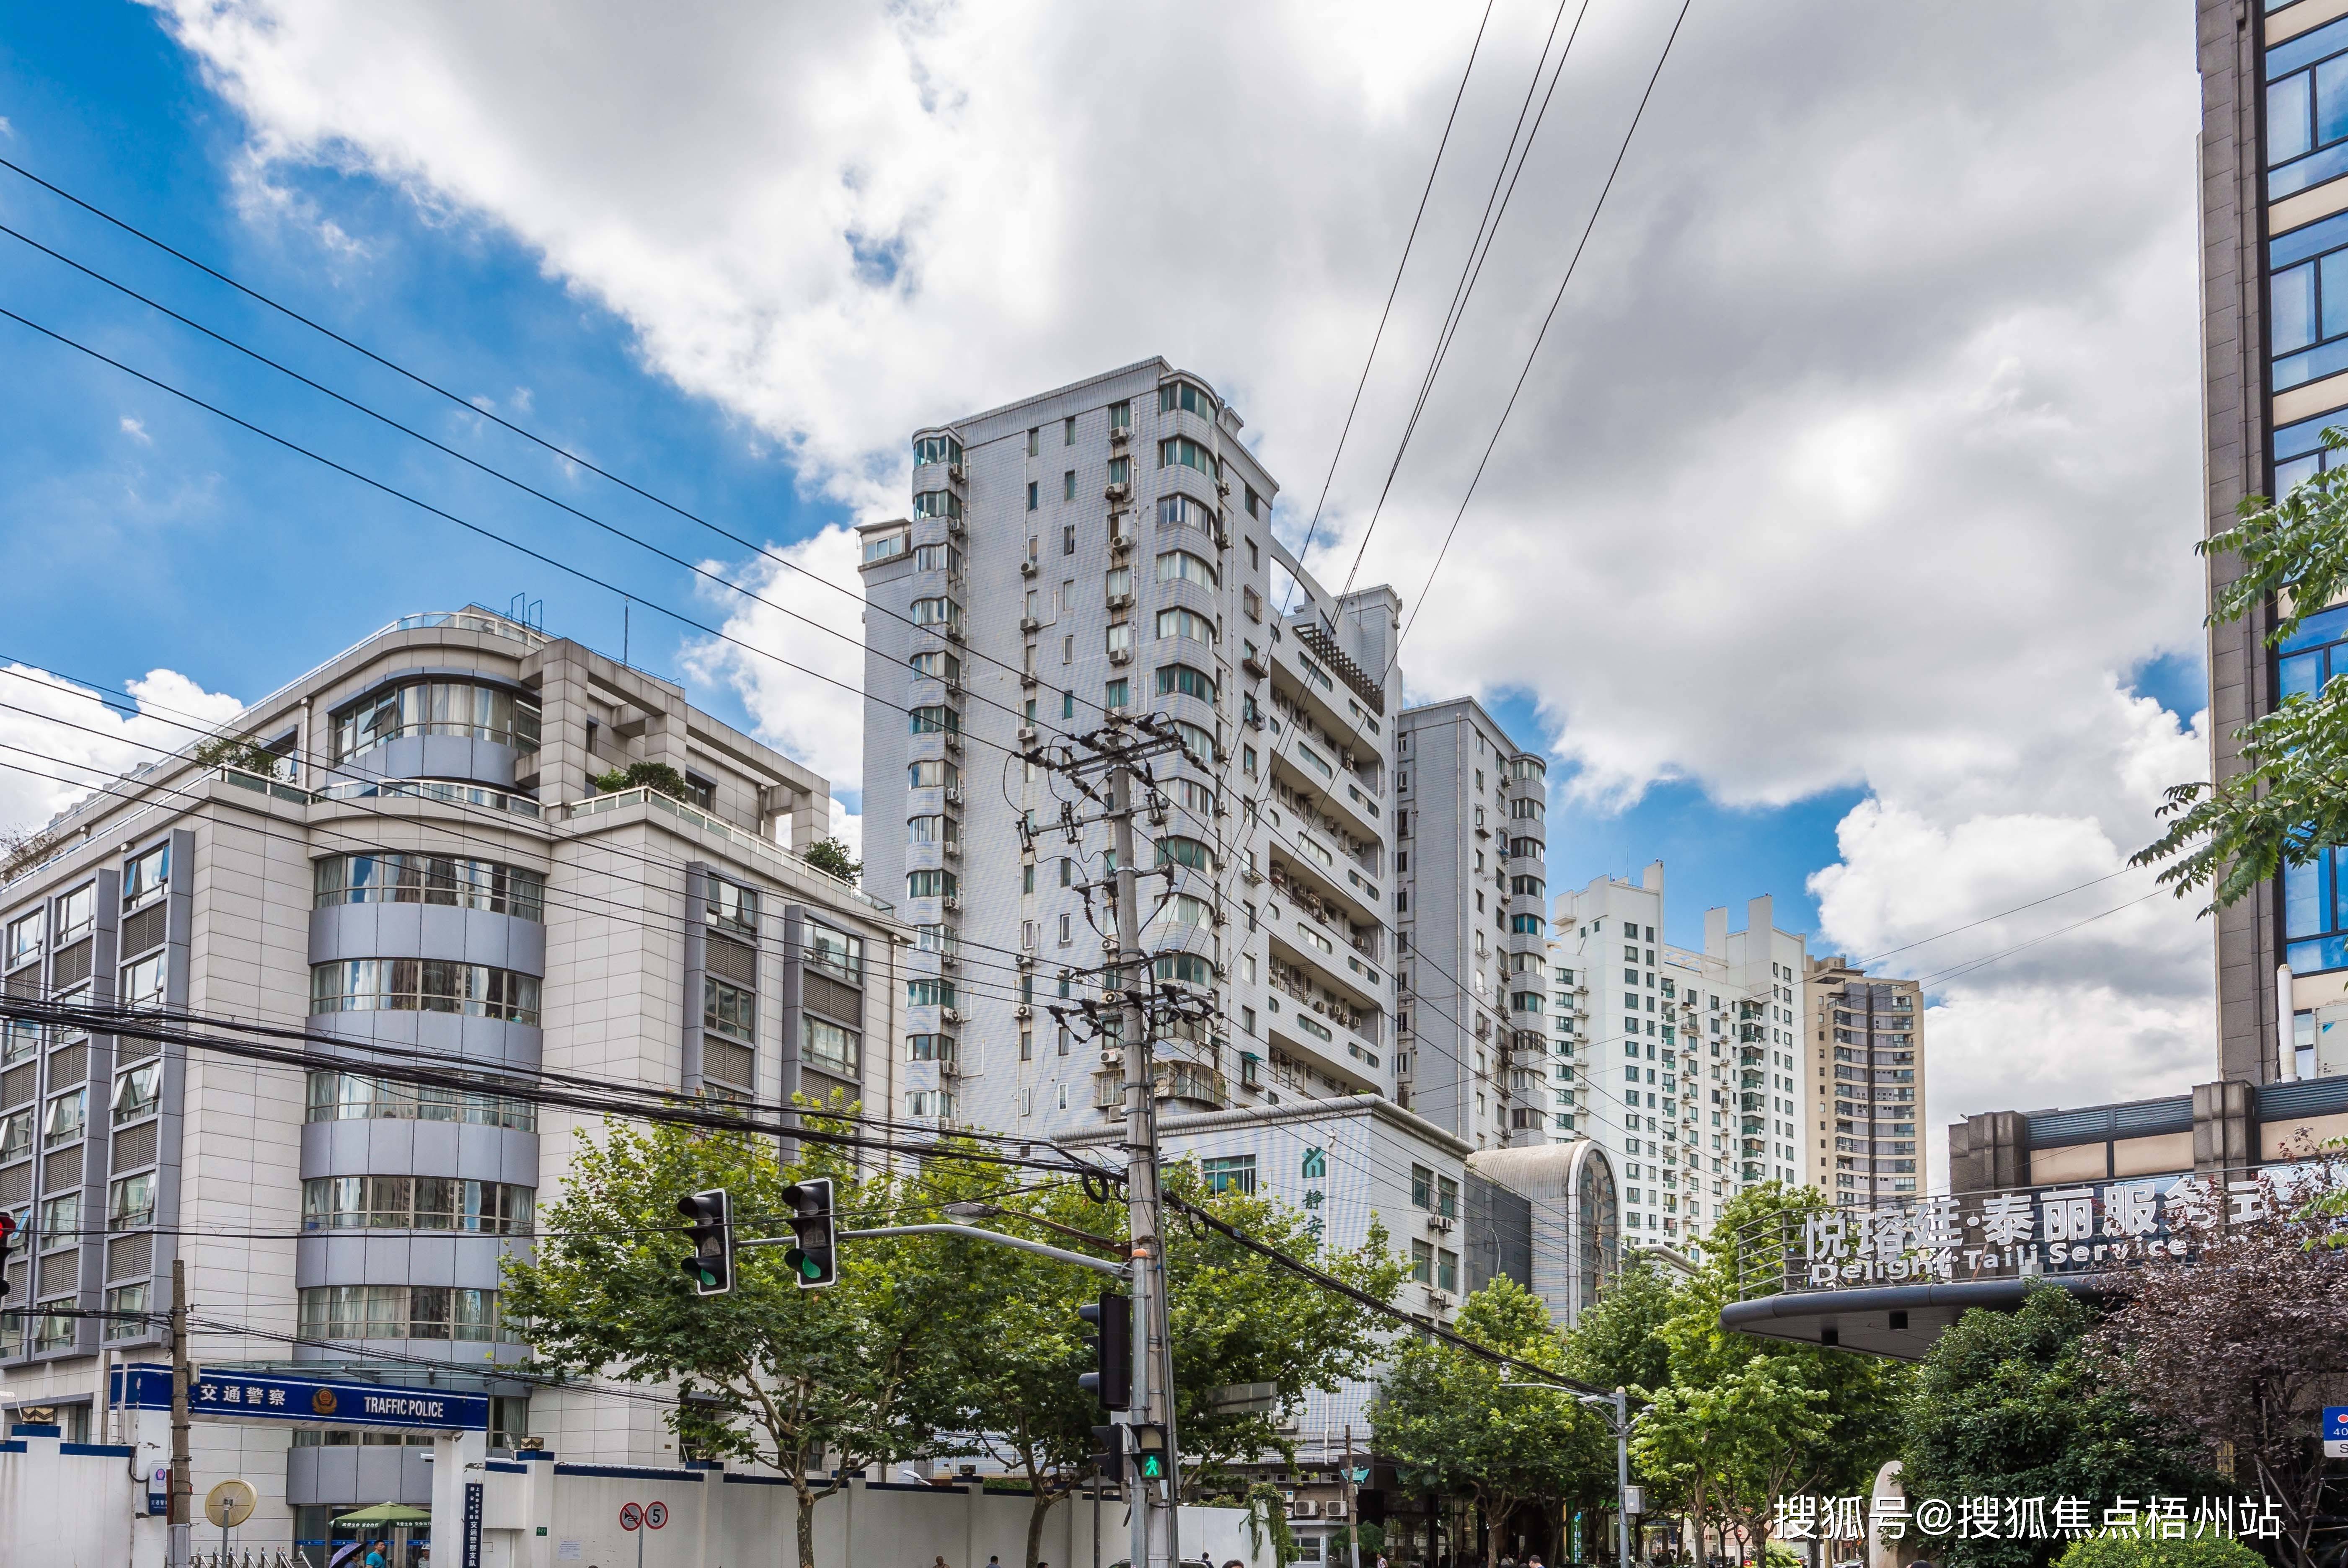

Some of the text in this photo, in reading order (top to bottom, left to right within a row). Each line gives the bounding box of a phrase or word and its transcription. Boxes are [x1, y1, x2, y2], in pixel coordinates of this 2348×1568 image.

[2049, 1236, 2188, 1264] Service
[200, 1384, 286, 1405] 交通警察
[364, 1397, 444, 1418] TRAFFIC POLICE
[653, 1508, 661, 1523] 5
[469, 1521, 478, 1567] 交通警察支队
